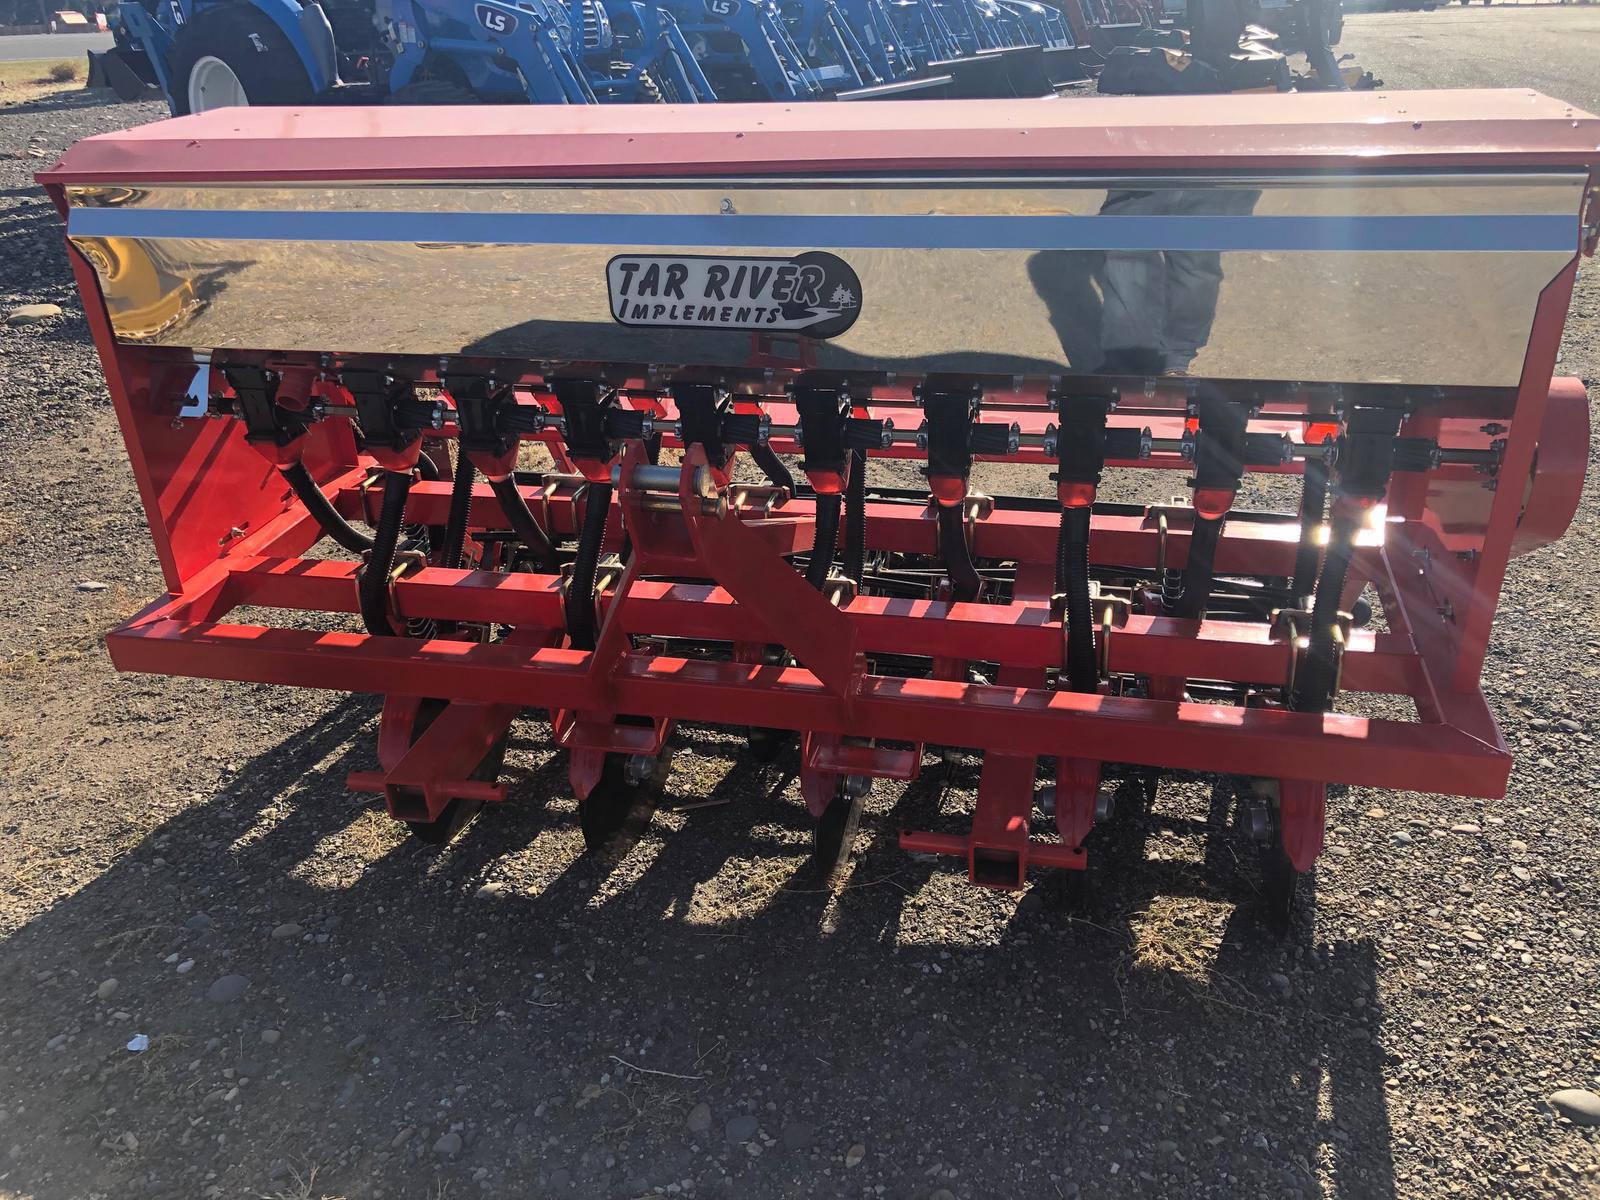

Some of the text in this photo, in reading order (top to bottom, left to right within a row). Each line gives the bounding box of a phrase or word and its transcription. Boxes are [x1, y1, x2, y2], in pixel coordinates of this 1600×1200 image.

[712, 0, 730, 14] LS
[485, 11, 505, 32] LS
[620, 263, 825, 306] TAR RIVER
[618, 298, 782, 324] IMPLEMENTS
